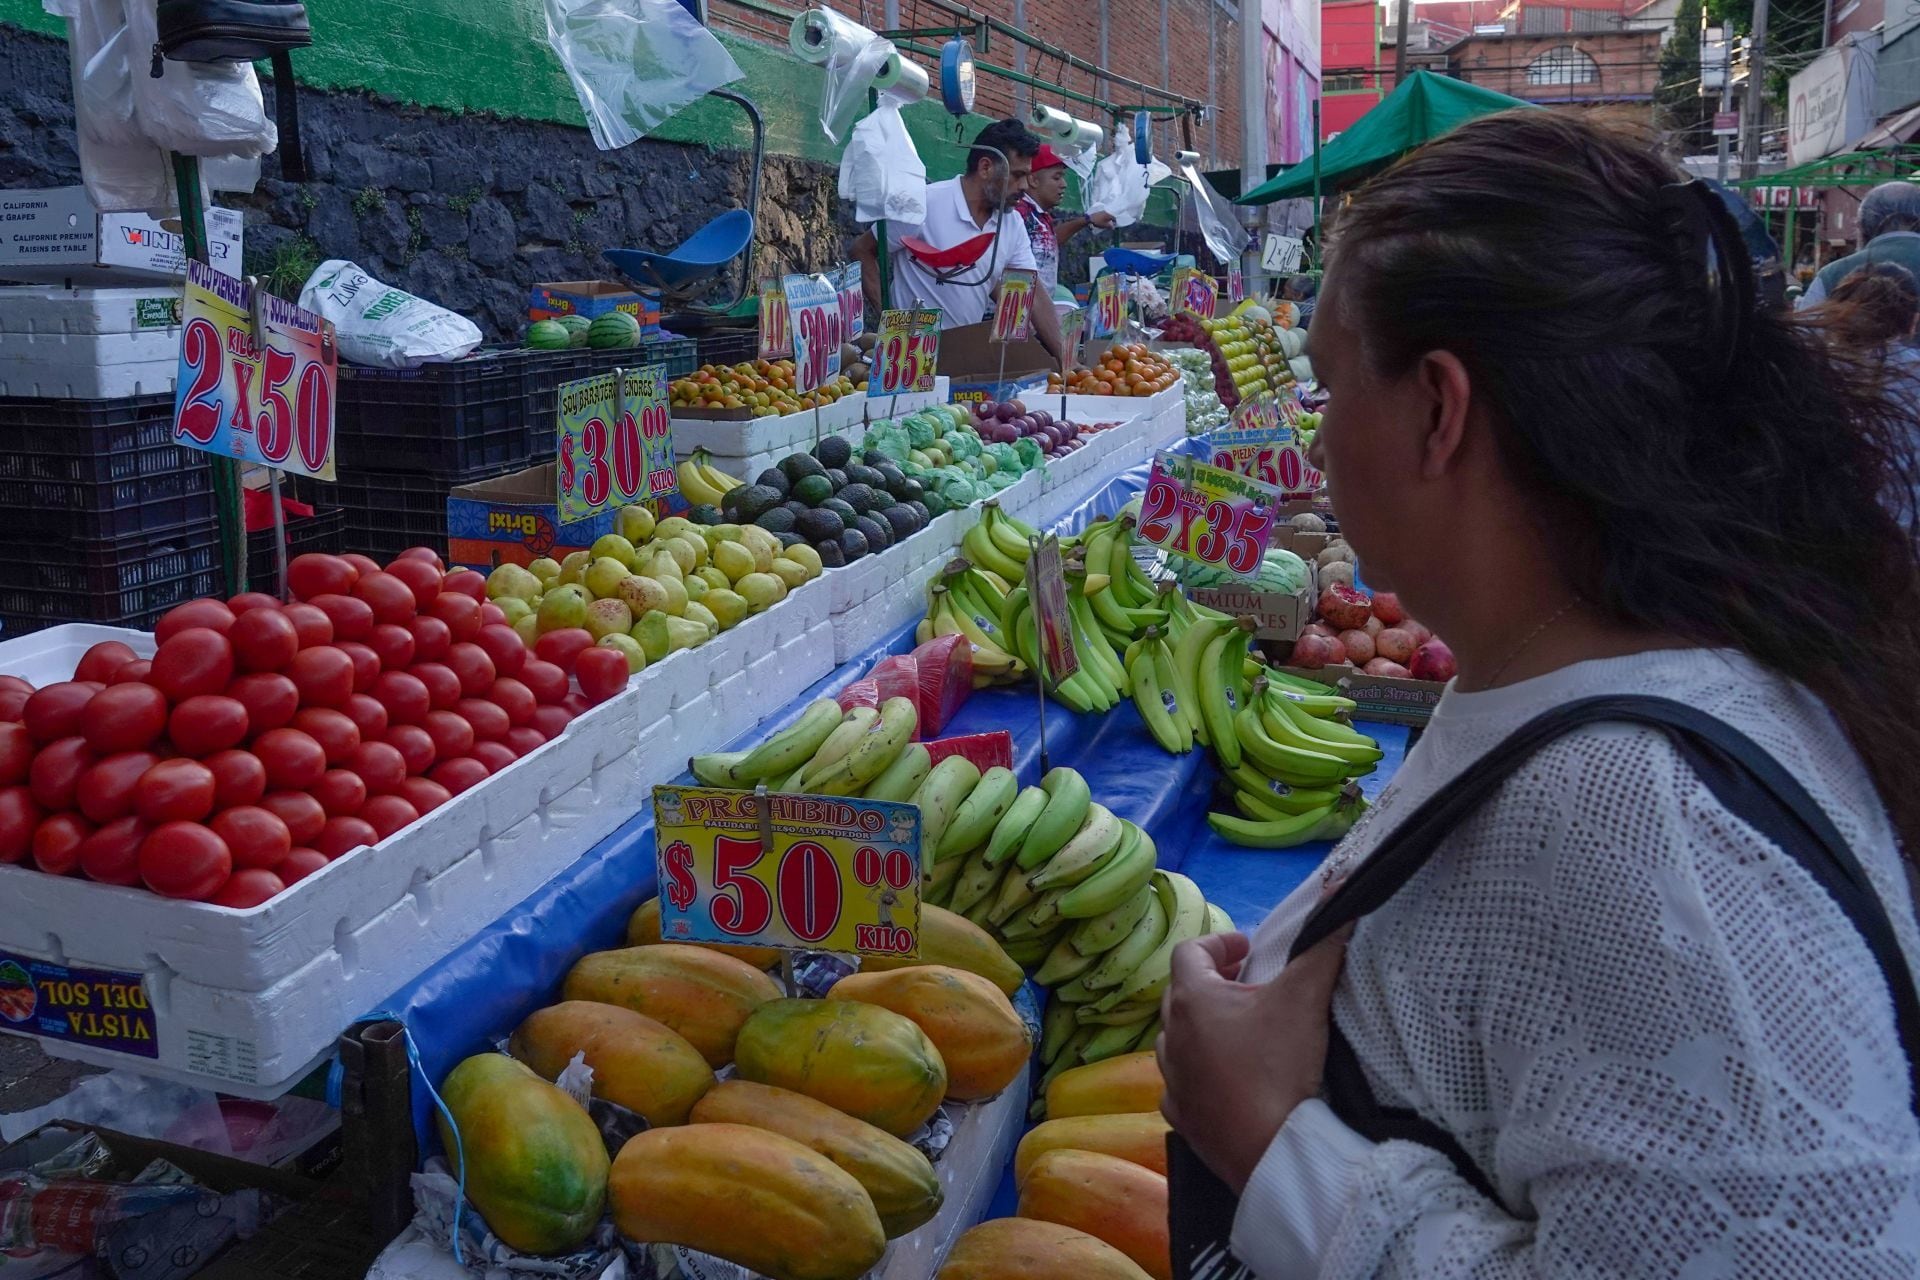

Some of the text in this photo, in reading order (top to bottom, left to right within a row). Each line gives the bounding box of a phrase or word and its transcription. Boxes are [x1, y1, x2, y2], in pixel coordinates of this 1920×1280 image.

[6, 213, 36, 221] GRAPES
[19, 245, 49, 253] RAISINS
[63, 244, 87, 252] TABLE
[121, 226, 228, 258] VINMR
[188, 261, 201, 285] NO
[201, 265, 212, 290] LO
[211, 269, 241, 307] PIENSE
[270, 297, 289, 325] SOLO
[289, 304, 319, 334] CALIDAD
[327, 274, 369, 307] Zulka
[563, 393, 577, 415] SOY
[624, 376, 653, 397] EÑORES
[642, 403, 668, 441] 00
[1232, 447, 1256, 460] PIEZAS
[648, 467, 675, 494] KILO
[1179, 487, 1208, 507] KILOS
[489, 512, 537, 535] Brixi
[1196, 592, 1262, 609] EMIUM
[1347, 686, 1381, 698] each
[684, 795, 885, 833] PROHIBIDO
[703, 820, 753, 831] SALUDAR
[771, 824, 796, 834] BESO
[797, 826, 814, 836] AL
[814, 828, 872, 840] VENDEDOR
[853, 846, 913, 890] 00
[855, 924, 913, 953] KILO
[39, 981, 149, 1010] DEL SOL
[69, 1012, 151, 1040] VISTA
